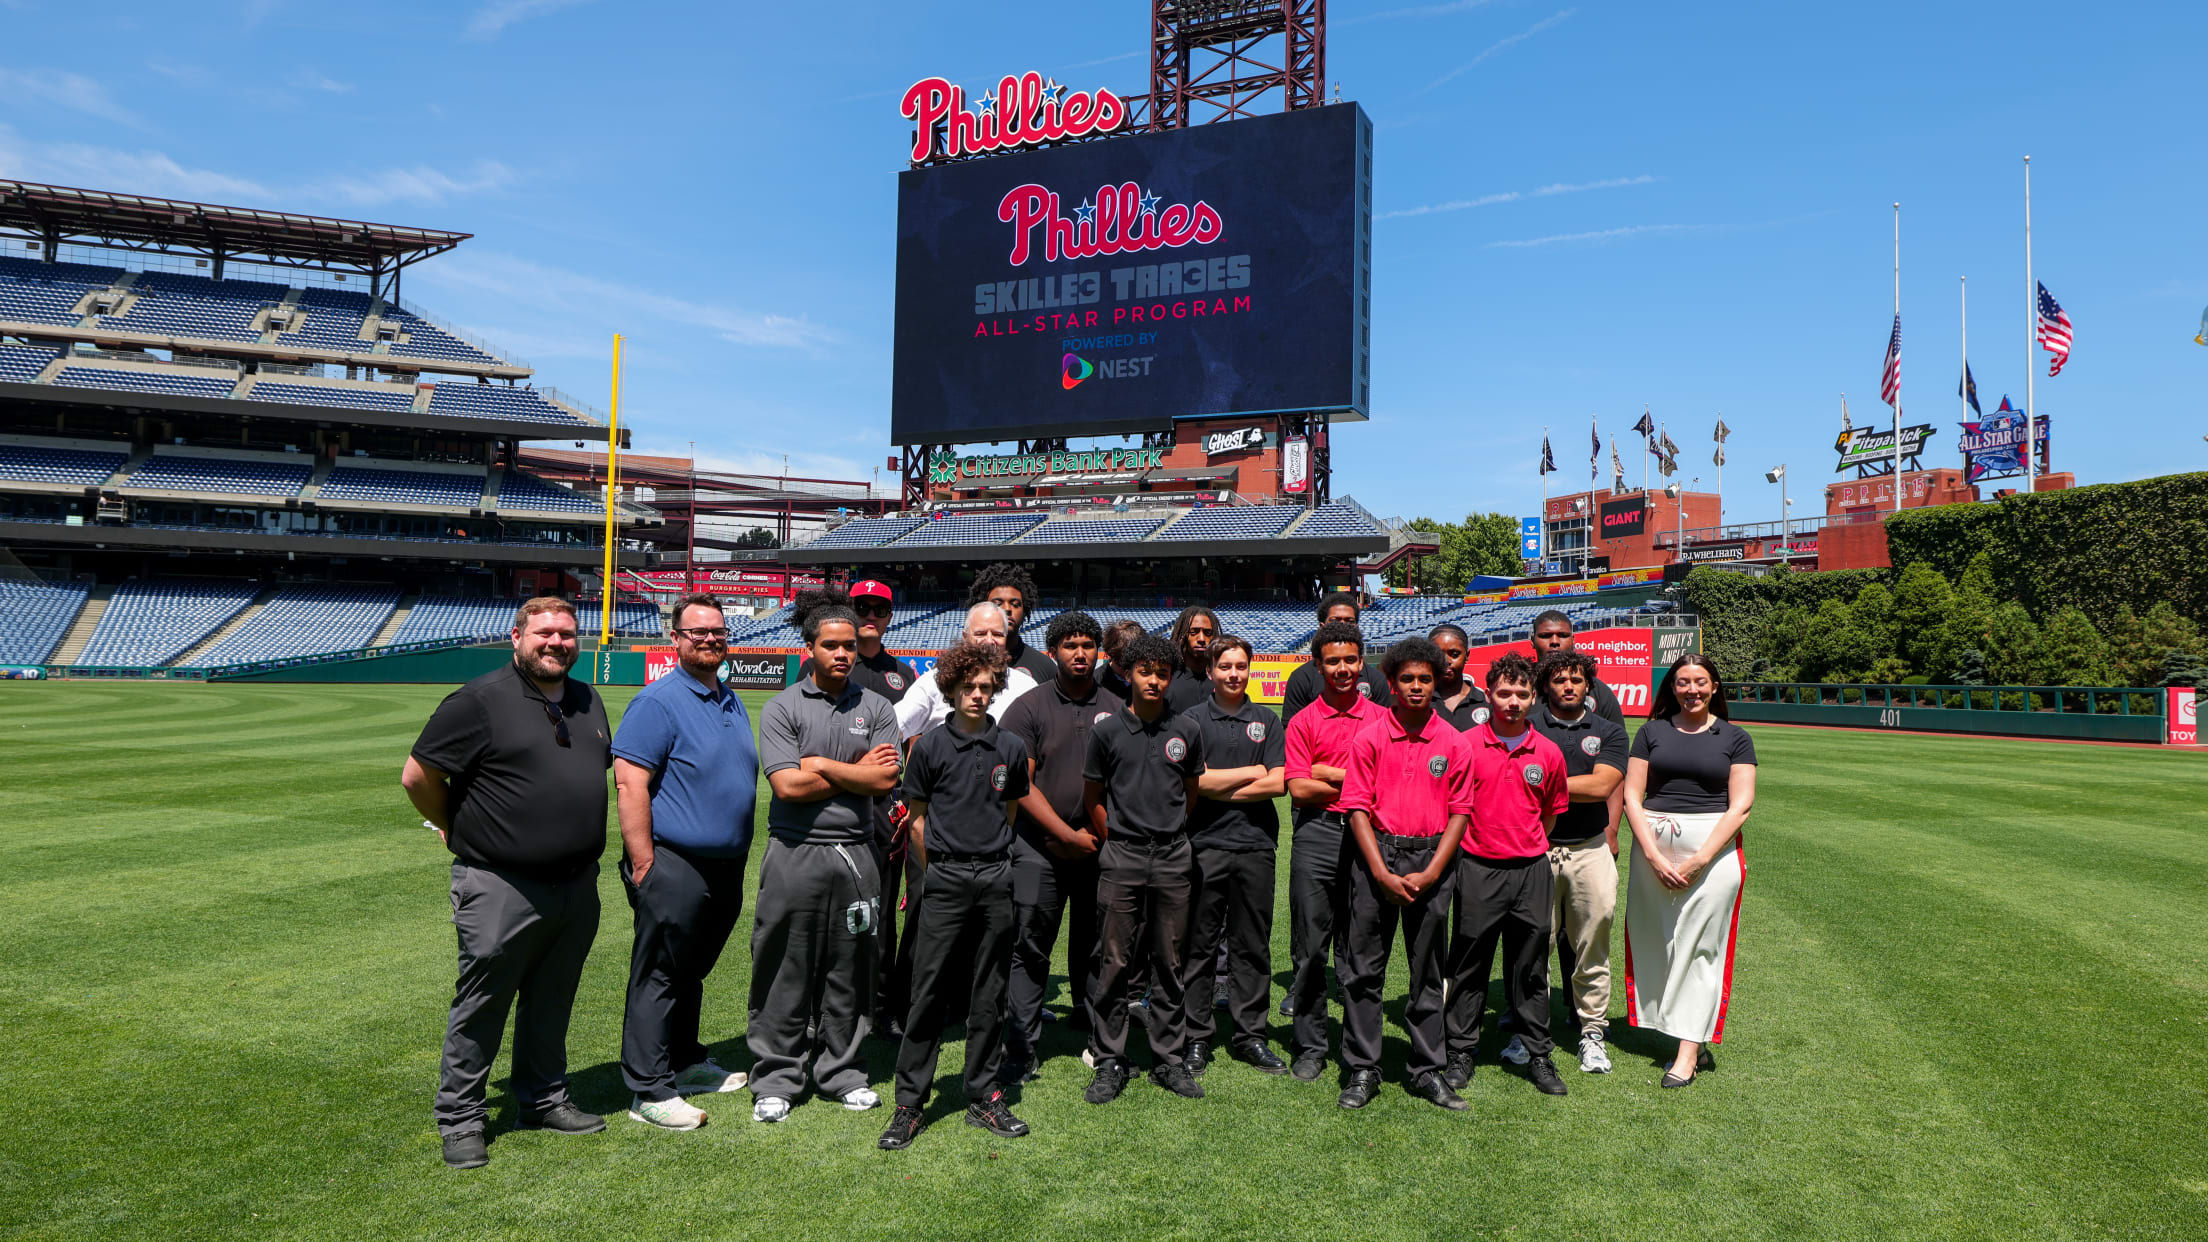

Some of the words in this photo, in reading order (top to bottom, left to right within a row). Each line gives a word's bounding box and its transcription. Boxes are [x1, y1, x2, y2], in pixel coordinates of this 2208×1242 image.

[900, 71, 1125, 162] Phillies
[998, 181, 1223, 266] Phillies
[974, 311, 1098, 338] ALL-STAR
[1114, 295, 1251, 325] PROGRAM
[1062, 333, 1134, 351] POWERED
[1139, 331, 1158, 344] BY
[1099, 356, 1154, 379] NEST
[1208, 427, 1251, 455] GHOST
[1838, 432, 1854, 445] PJ
[1959, 434, 1982, 451] ALL
[1983, 430, 2013, 448] STAR
[961, 454, 1047, 476] Citizens
[1051, 446, 1107, 472] Bank
[1111, 444, 1163, 470] Park
[1604, 510, 1641, 527] GIANT
[1801, 540, 1818, 548] LU
[710, 570, 742, 581] Coca-Cola
[865, 581, 876, 592] P
[1598, 640, 1648, 652] neighbor,
[1659, 632, 1694, 649] MONTY'S
[731, 660, 785, 675] NovaCare
[1603, 655, 1612, 665] is
[731, 676, 782, 684] REHABILITATION
[1250, 671, 1266, 679] WHO
[1880, 709, 1900, 727] 401
[2170, 730, 2196, 741] TOY
